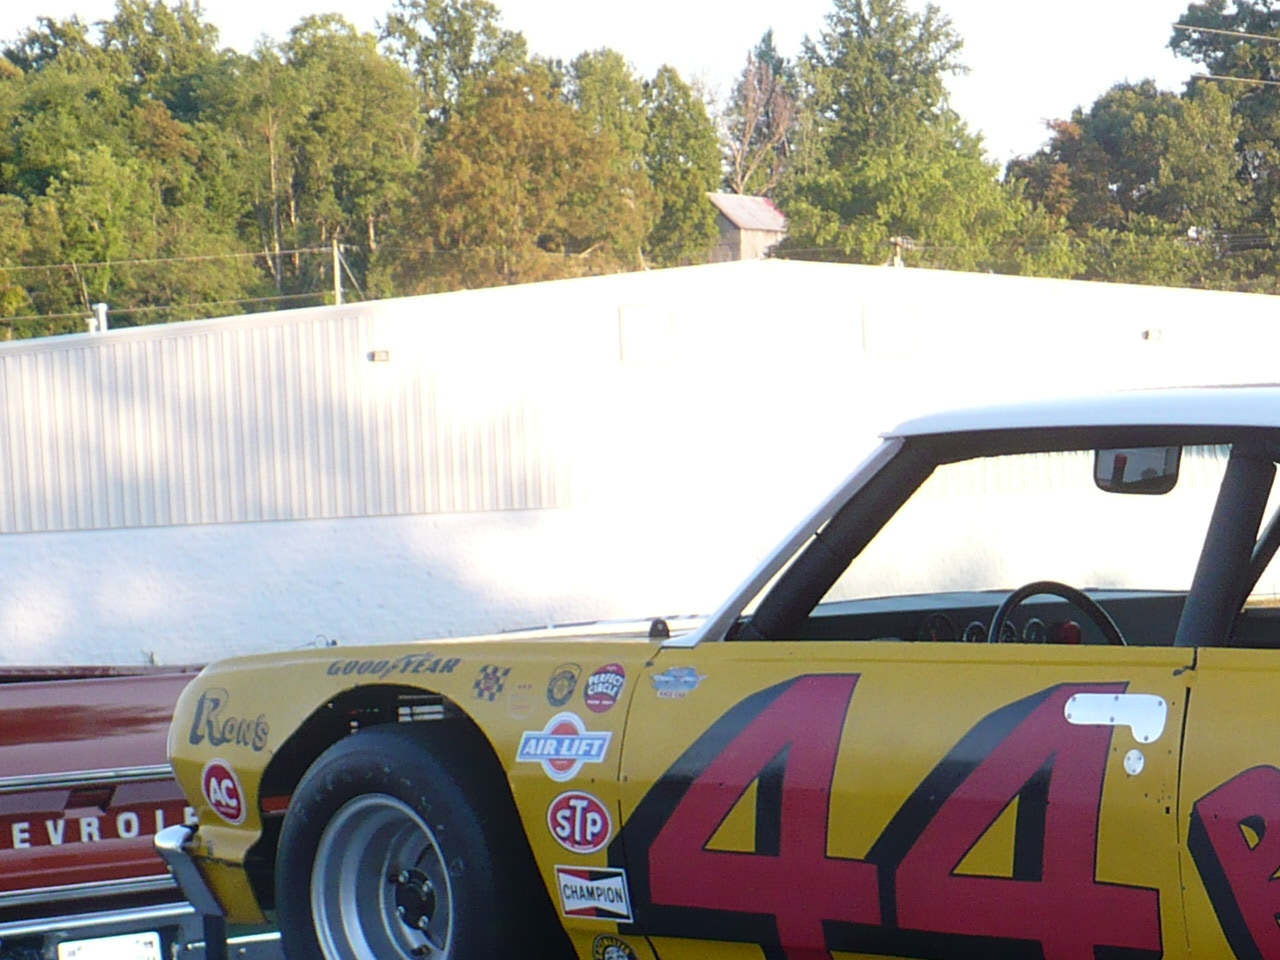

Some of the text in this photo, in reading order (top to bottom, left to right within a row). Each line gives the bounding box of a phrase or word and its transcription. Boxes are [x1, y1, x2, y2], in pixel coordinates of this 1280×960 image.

[588, 673, 624, 686] PERFECT
[587, 683, 619, 697] CIRCLE
[523, 738, 603, 756] AIR LIFT
[209, 776, 239, 809] AC
[555, 798, 603, 844] STP
[562, 883, 624, 904] CHAMPION
